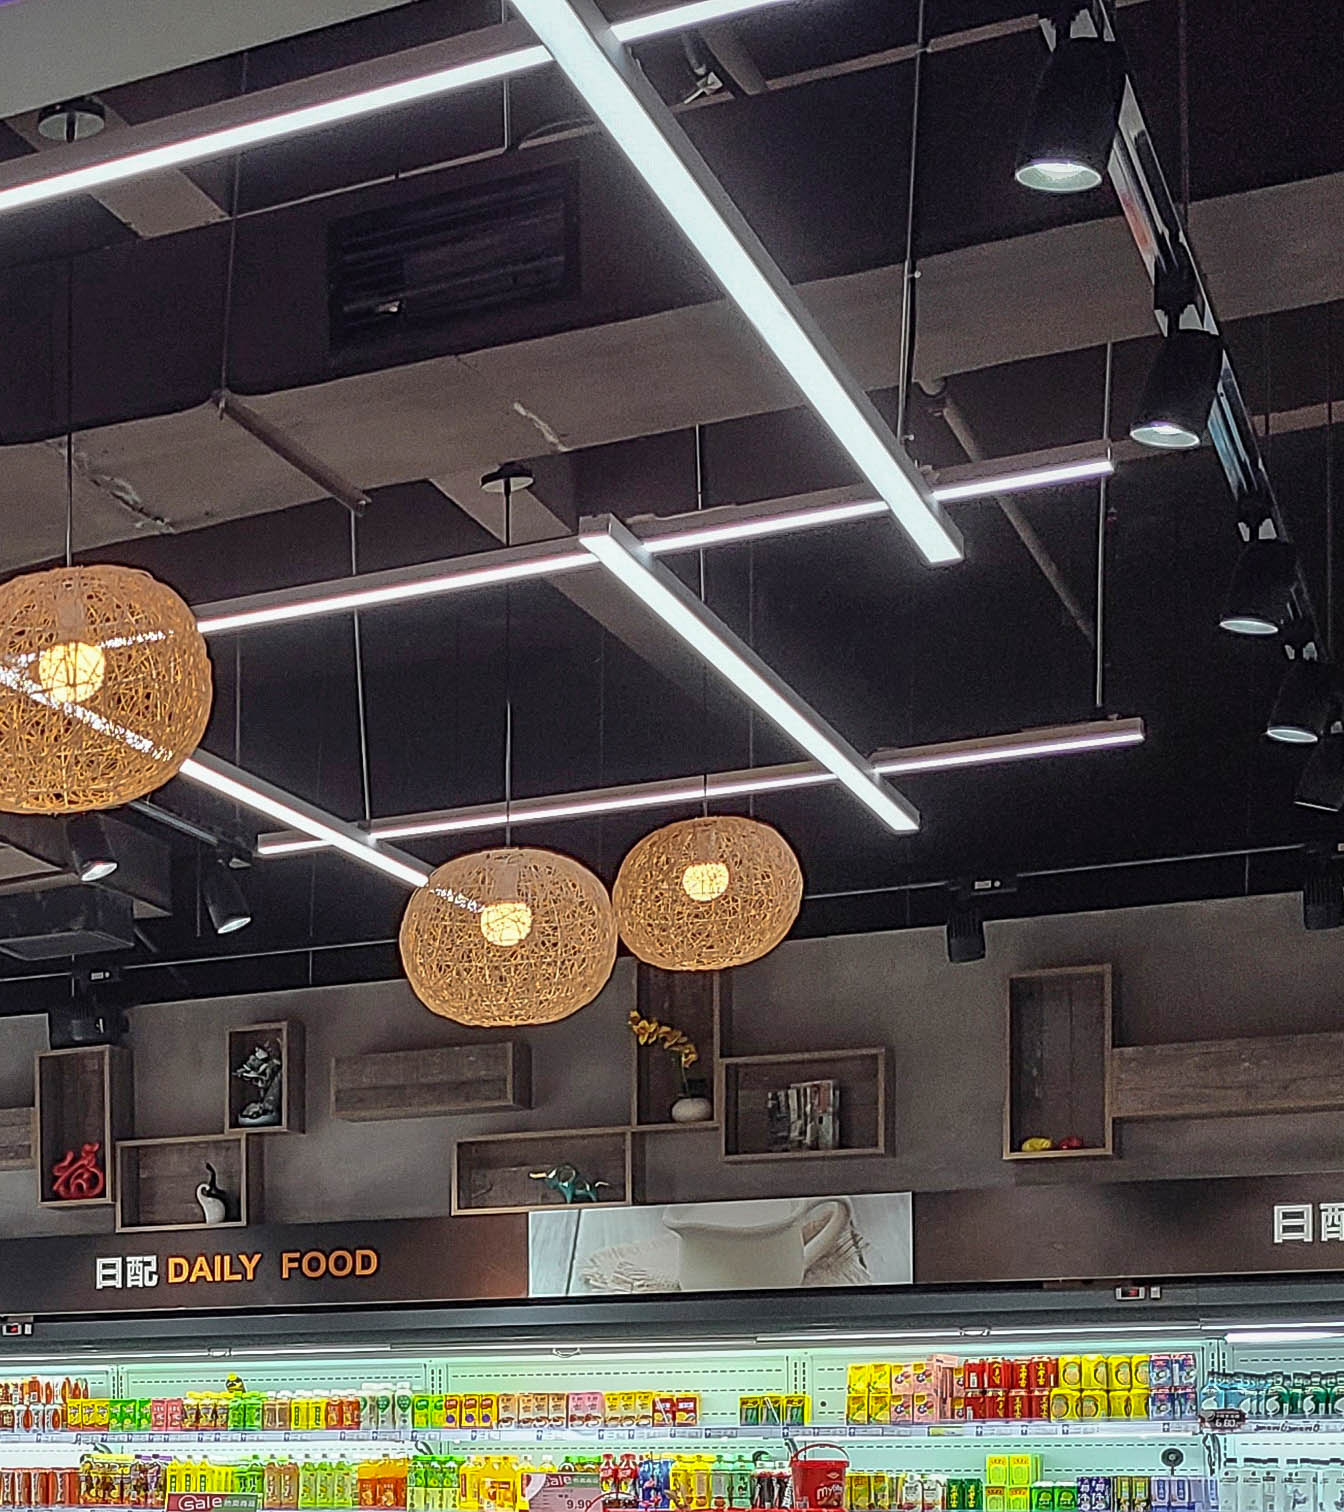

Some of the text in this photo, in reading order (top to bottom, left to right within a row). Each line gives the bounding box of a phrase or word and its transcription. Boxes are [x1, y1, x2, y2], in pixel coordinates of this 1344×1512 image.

[95, 1249, 378, 1289] 日配 DAILY FOOD
